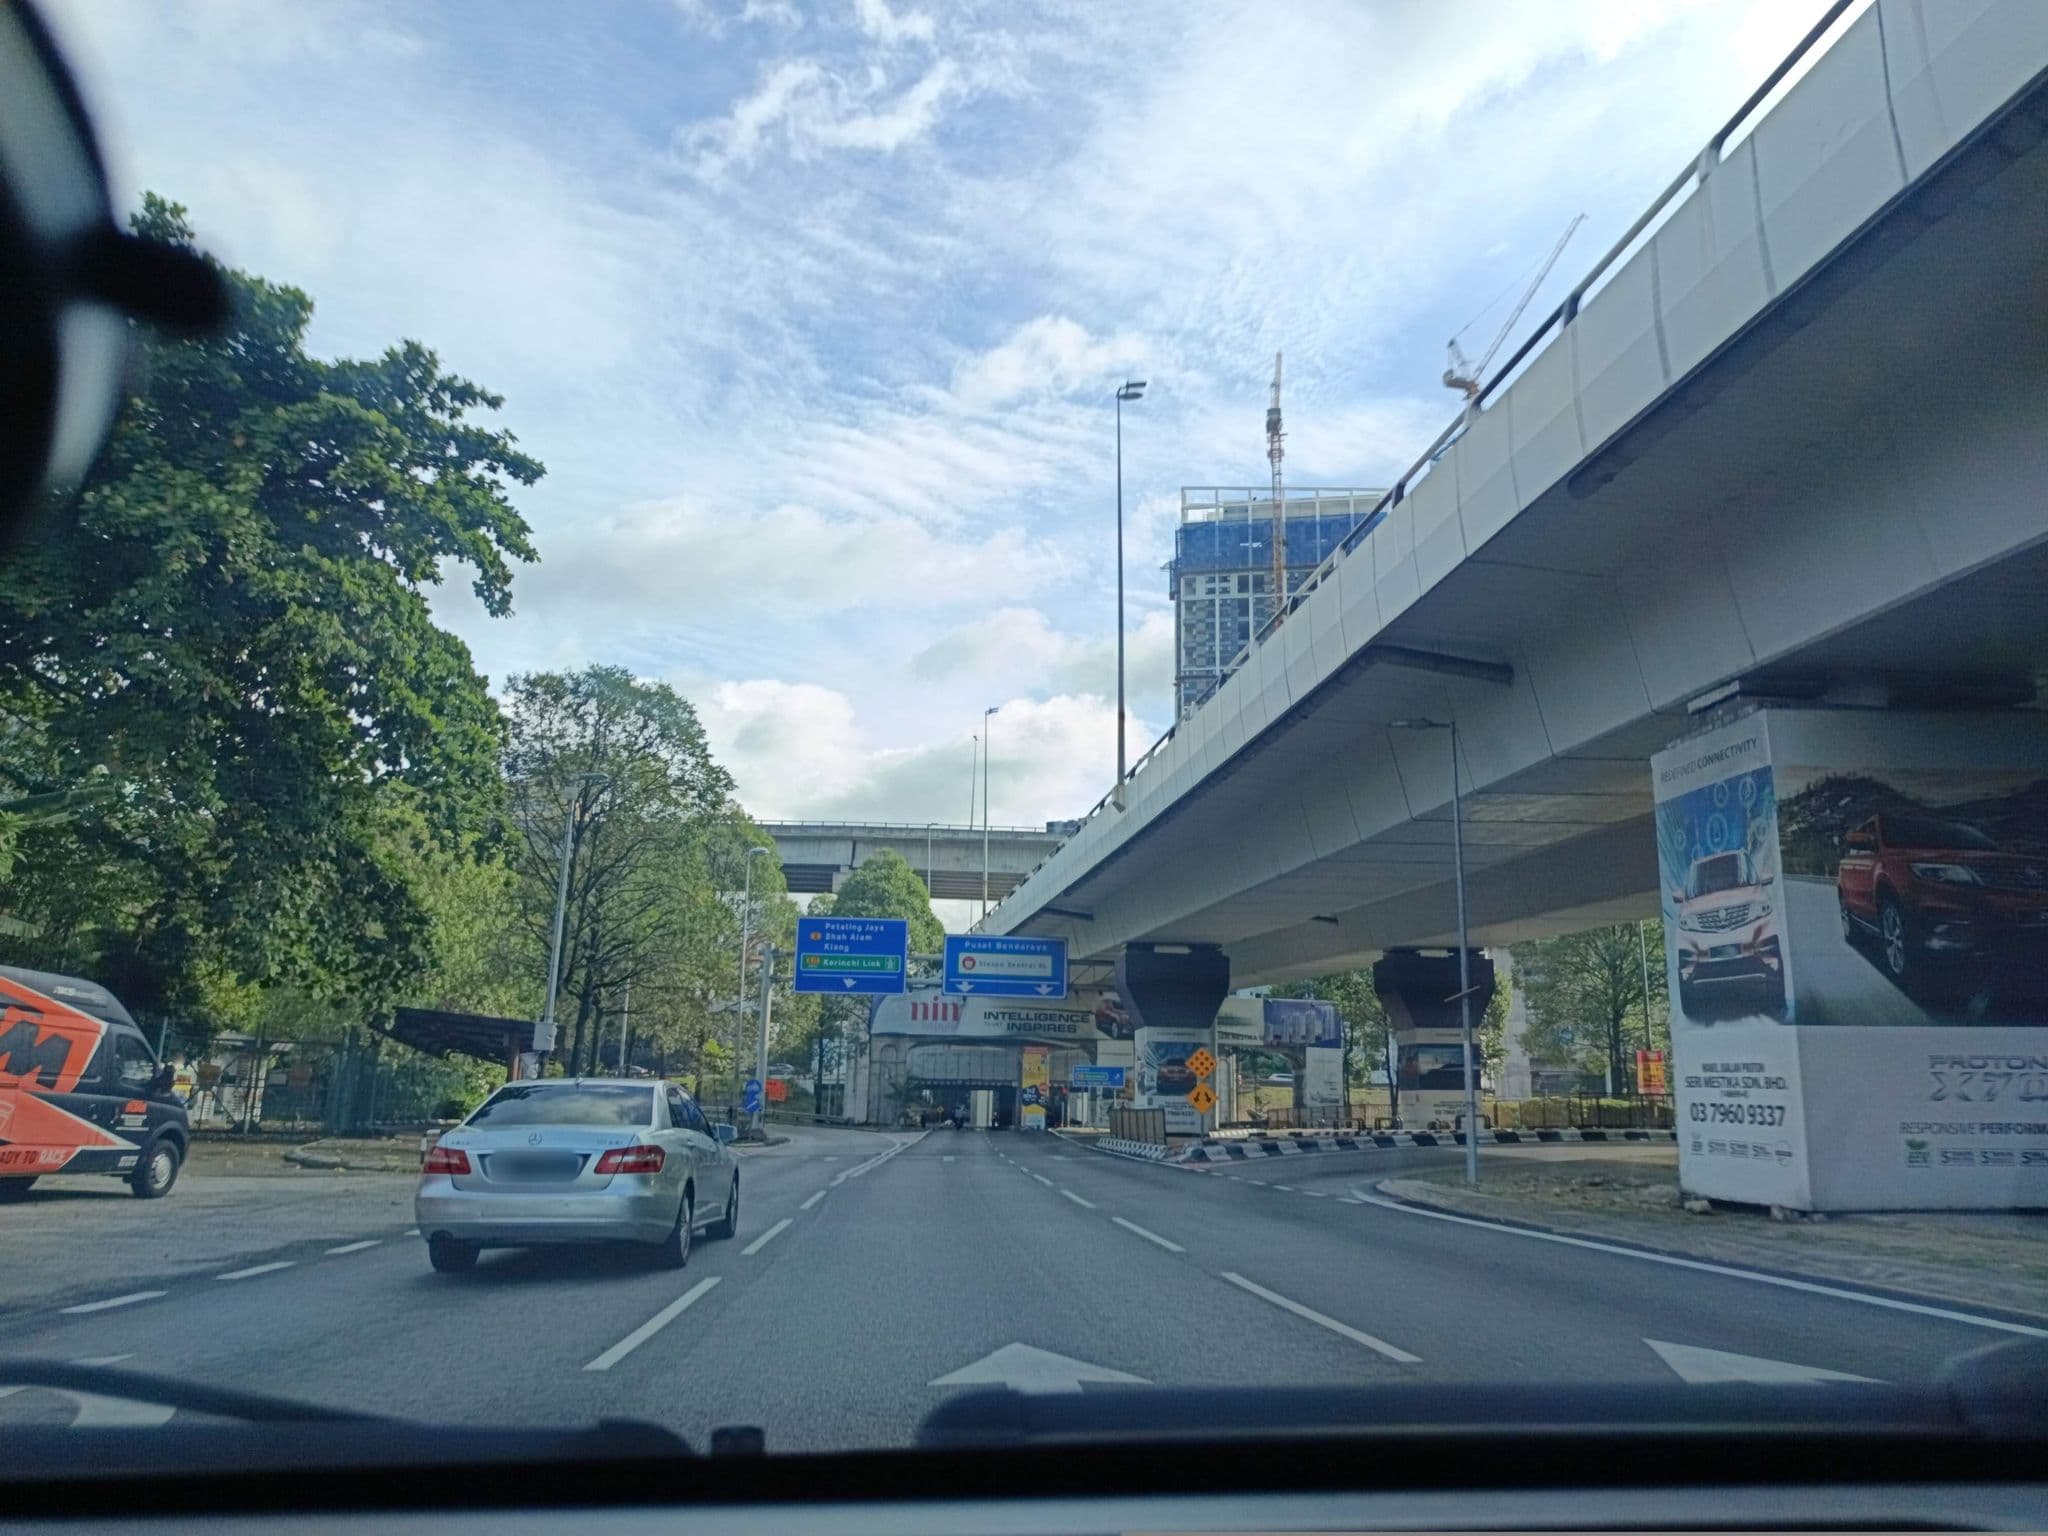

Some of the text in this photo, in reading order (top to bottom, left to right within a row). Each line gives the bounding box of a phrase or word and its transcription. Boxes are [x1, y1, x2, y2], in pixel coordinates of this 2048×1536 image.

[1696, 737, 1757, 769] CONNECTIVITY
[825, 922, 884, 933] Petaling Jaya
[825, 932, 847, 941] Shah
[849, 933, 873, 941] Alam
[823, 943, 850, 953] Klang
[964, 941, 992, 949] Pusat
[823, 958, 860, 967] Kerinchi
[862, 959, 881, 967] Link
[984, 1011, 1090, 1023] INTELLIGENCE
[1006, 1022, 1077, 1033] INSPIRES
[1928, 1055, 2048, 1069] PROTON
[1690, 1102, 1786, 1127] 03 7960 9337
